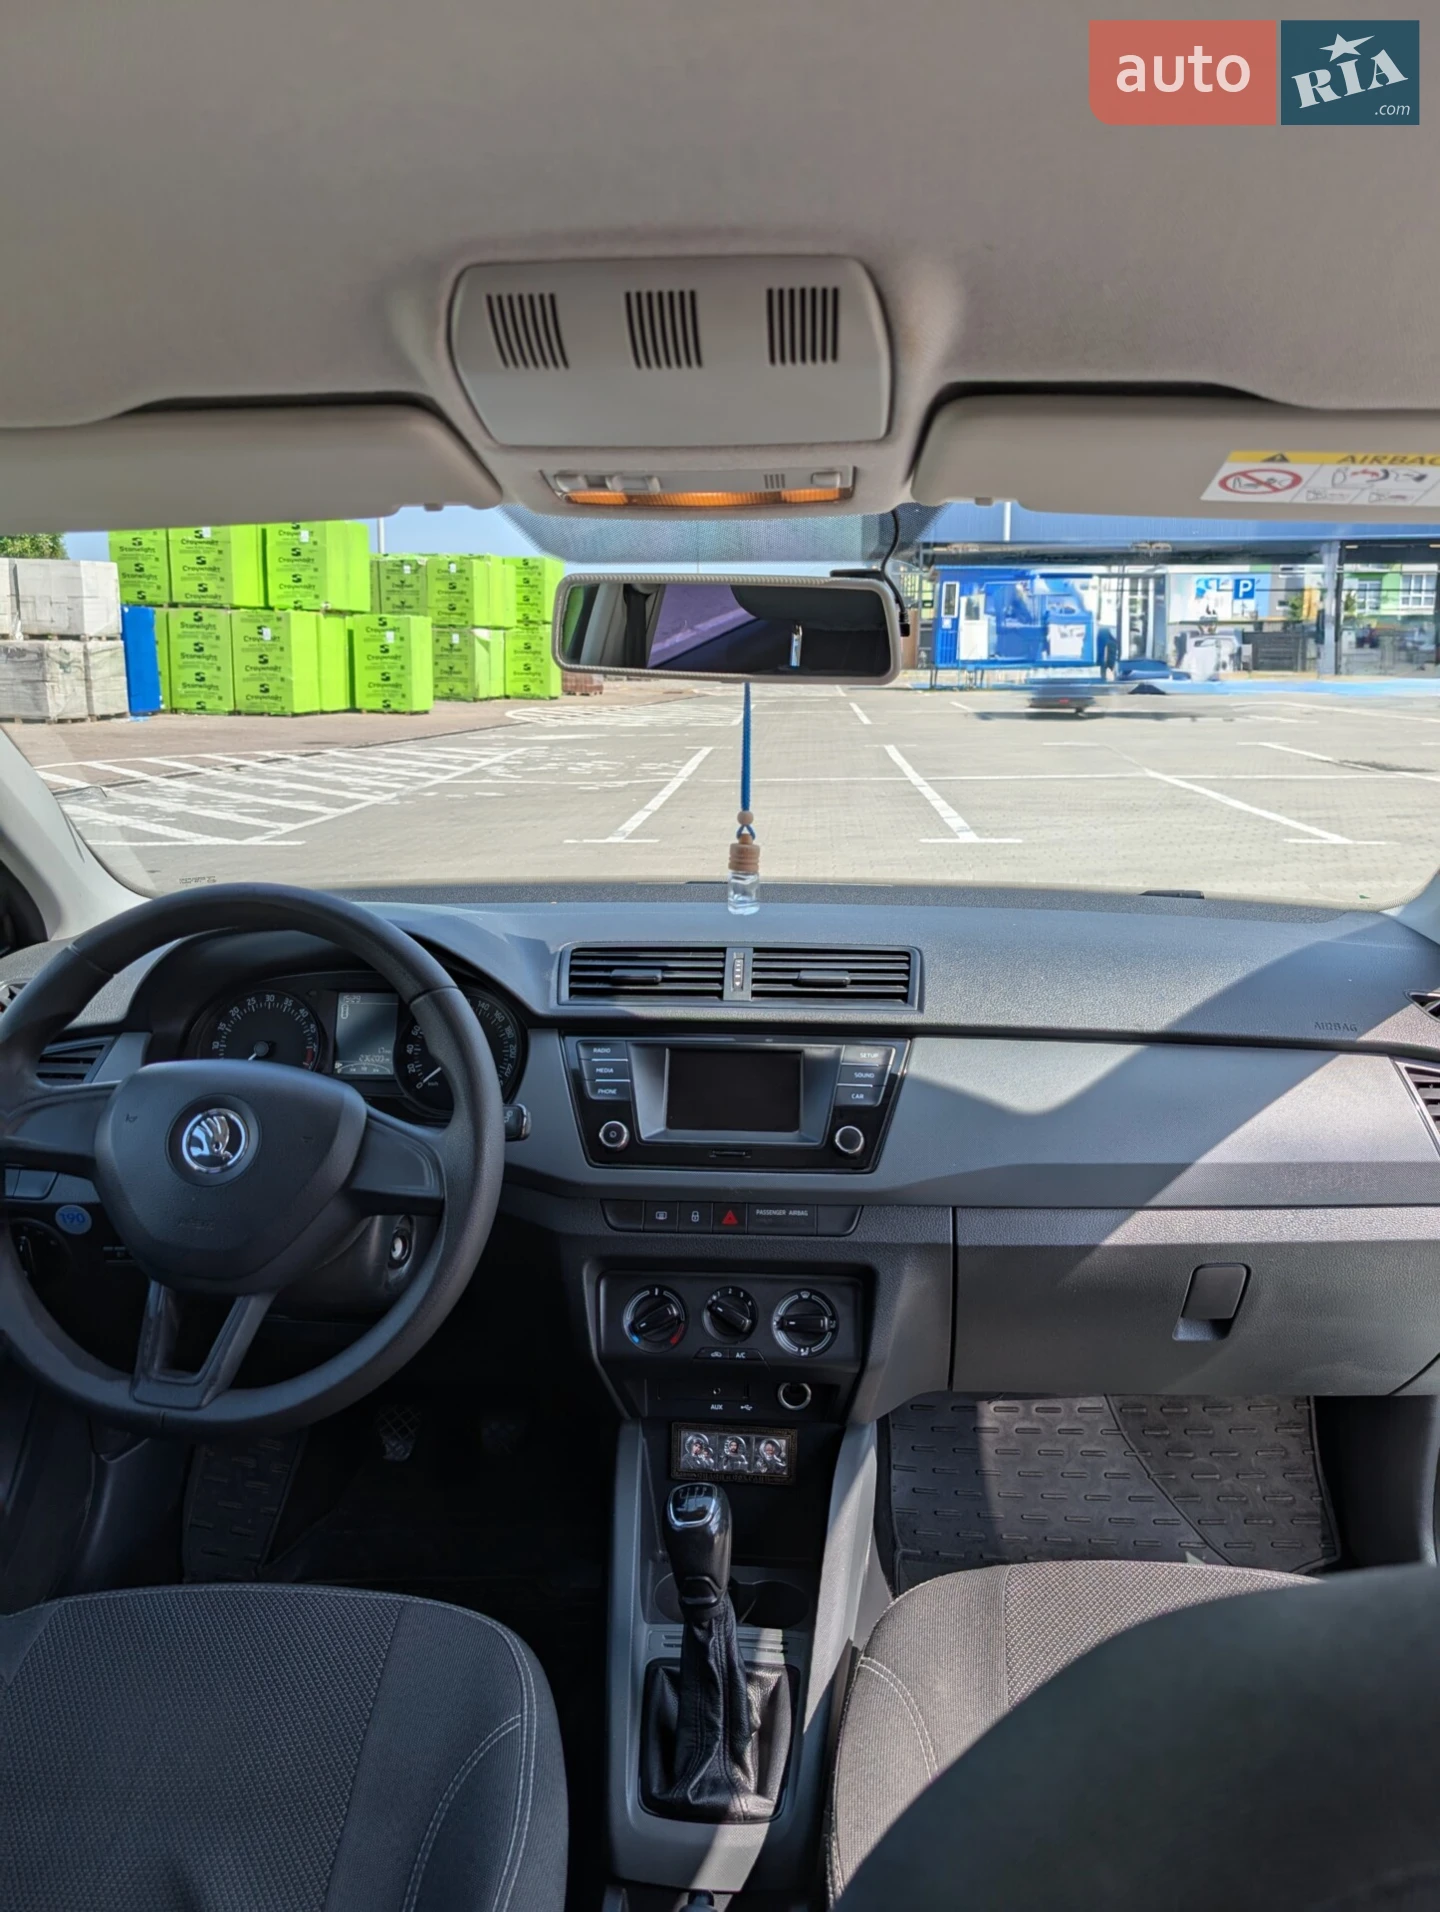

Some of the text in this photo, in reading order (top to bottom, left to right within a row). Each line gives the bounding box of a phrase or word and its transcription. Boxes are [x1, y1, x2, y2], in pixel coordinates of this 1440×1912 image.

[1238, 580, 1253, 598] P
[246, 997, 257, 1006] 25
[265, 994, 275, 1002] 30
[283, 997, 294, 1007] 35
[477, 1000, 490, 1011] 140
[229, 1006, 240, 1017] 20
[299, 1008, 309, 1018] 40
[494, 1010, 505, 1022] 160
[411, 1025, 421, 1036] 60
[1314, 1021, 1358, 1032] AIRBAG
[406, 1044, 414, 1055] 40
